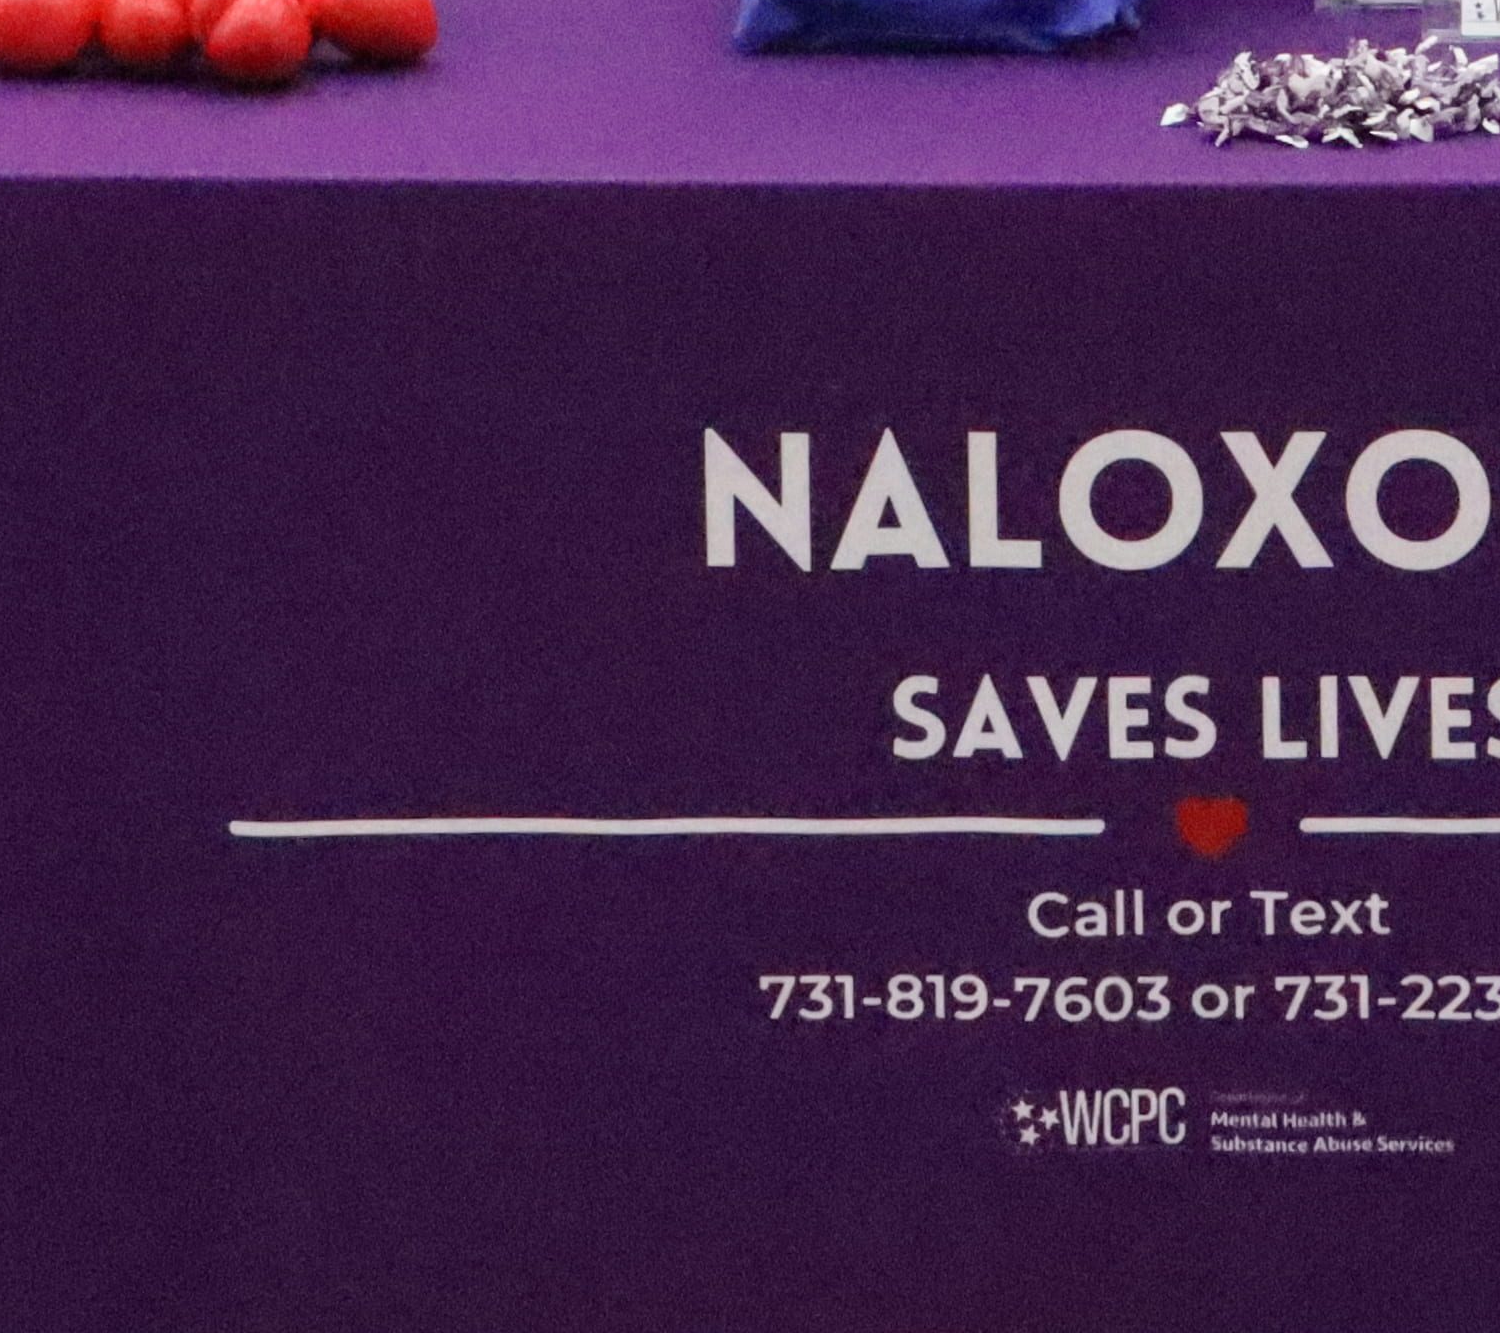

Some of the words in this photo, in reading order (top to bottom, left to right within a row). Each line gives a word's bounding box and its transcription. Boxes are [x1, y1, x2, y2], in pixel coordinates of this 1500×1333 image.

[891, 672, 1218, 763] SAVES
[1026, 888, 1146, 939] Call
[1165, 899, 1234, 937] or
[1248, 889, 1392, 937] Text
[758, 973, 1172, 1024] 731-819-7603
[1190, 983, 1257, 1021] or
[1060, 1086, 1186, 1145] WCPC
[1211, 1111, 1278, 1128] Mental
[1282, 1111, 1347, 1128] Health
[1352, 1110, 1367, 1127] &
[1211, 1135, 1309, 1153] Substance
[1313, 1136, 1373, 1152] Abuse
[1376, 1135, 1455, 1153] Services
